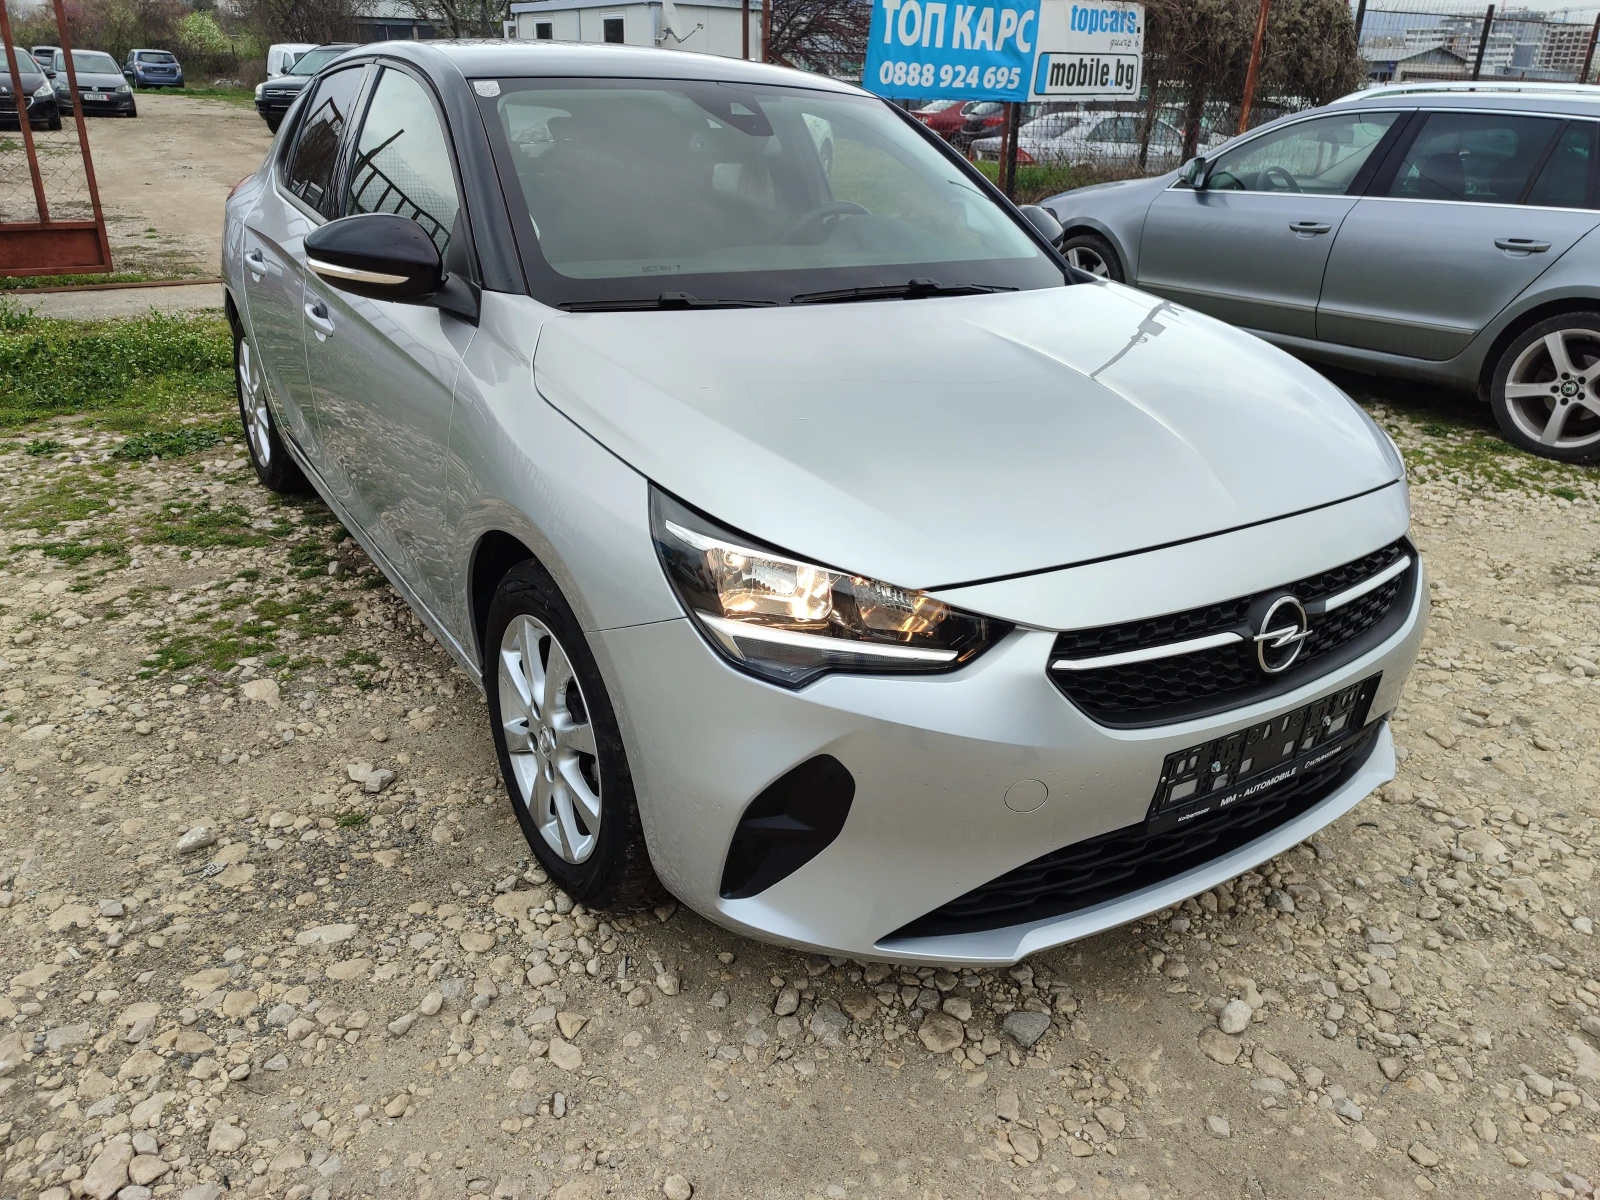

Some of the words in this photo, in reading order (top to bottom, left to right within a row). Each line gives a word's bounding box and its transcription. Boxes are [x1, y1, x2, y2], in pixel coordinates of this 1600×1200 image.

[883, 0, 947, 48] ТОП
[952, 5, 1035, 53] КАРС
[879, 60, 935, 87] 0888
[939, 64, 979, 88] 924
[983, 66, 1021, 90] 695
[1049, 57, 1135, 90] mobile.bg
[1220, 793, 1238, 807] MM
[1243, 766, 1298, 798] AUTOMOBILE
